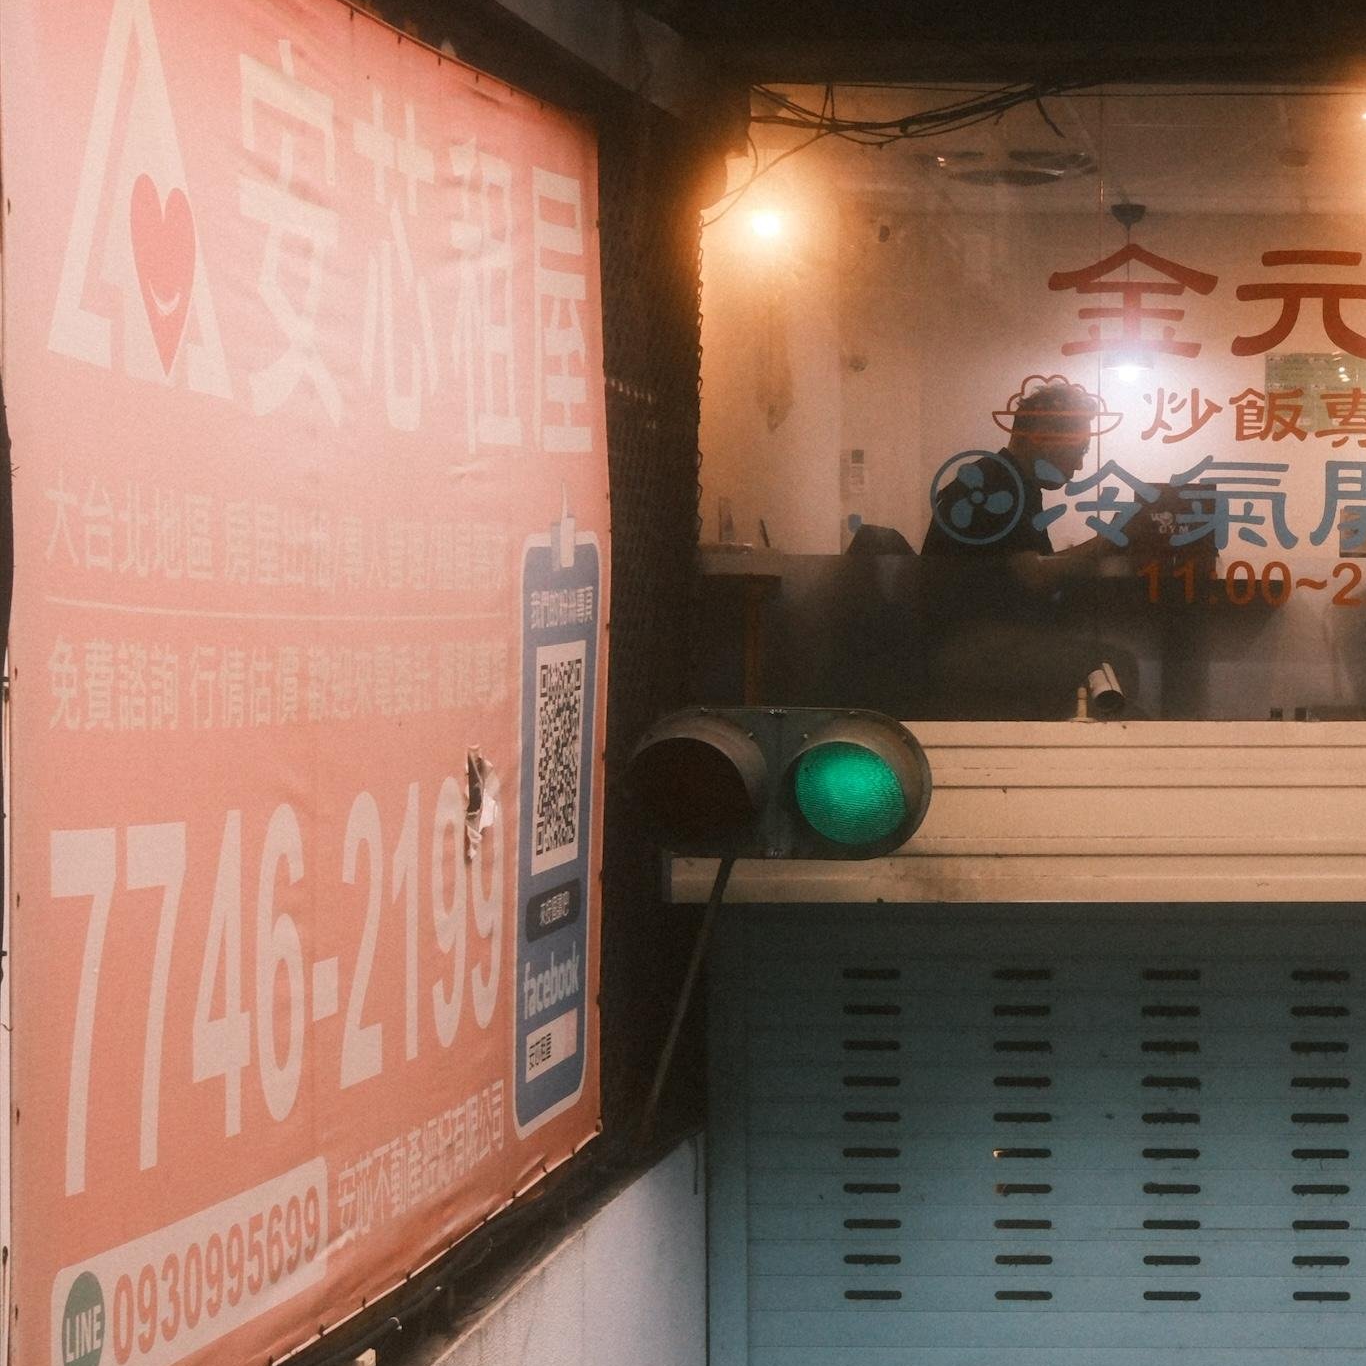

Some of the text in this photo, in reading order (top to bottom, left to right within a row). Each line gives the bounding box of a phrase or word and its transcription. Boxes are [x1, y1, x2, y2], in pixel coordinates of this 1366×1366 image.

[238, 38, 593, 456] 安芯租屋
[43, 469, 213, 581] 大台北地區
[48, 635, 180, 732] 免費諮詢
[190, 642, 300, 728] 行情估價
[50, 777, 504, 1198] 7746-2199
[523, 941, 580, 1021] facebook
[64, 1185, 321, 1366] LINE 0930995699
